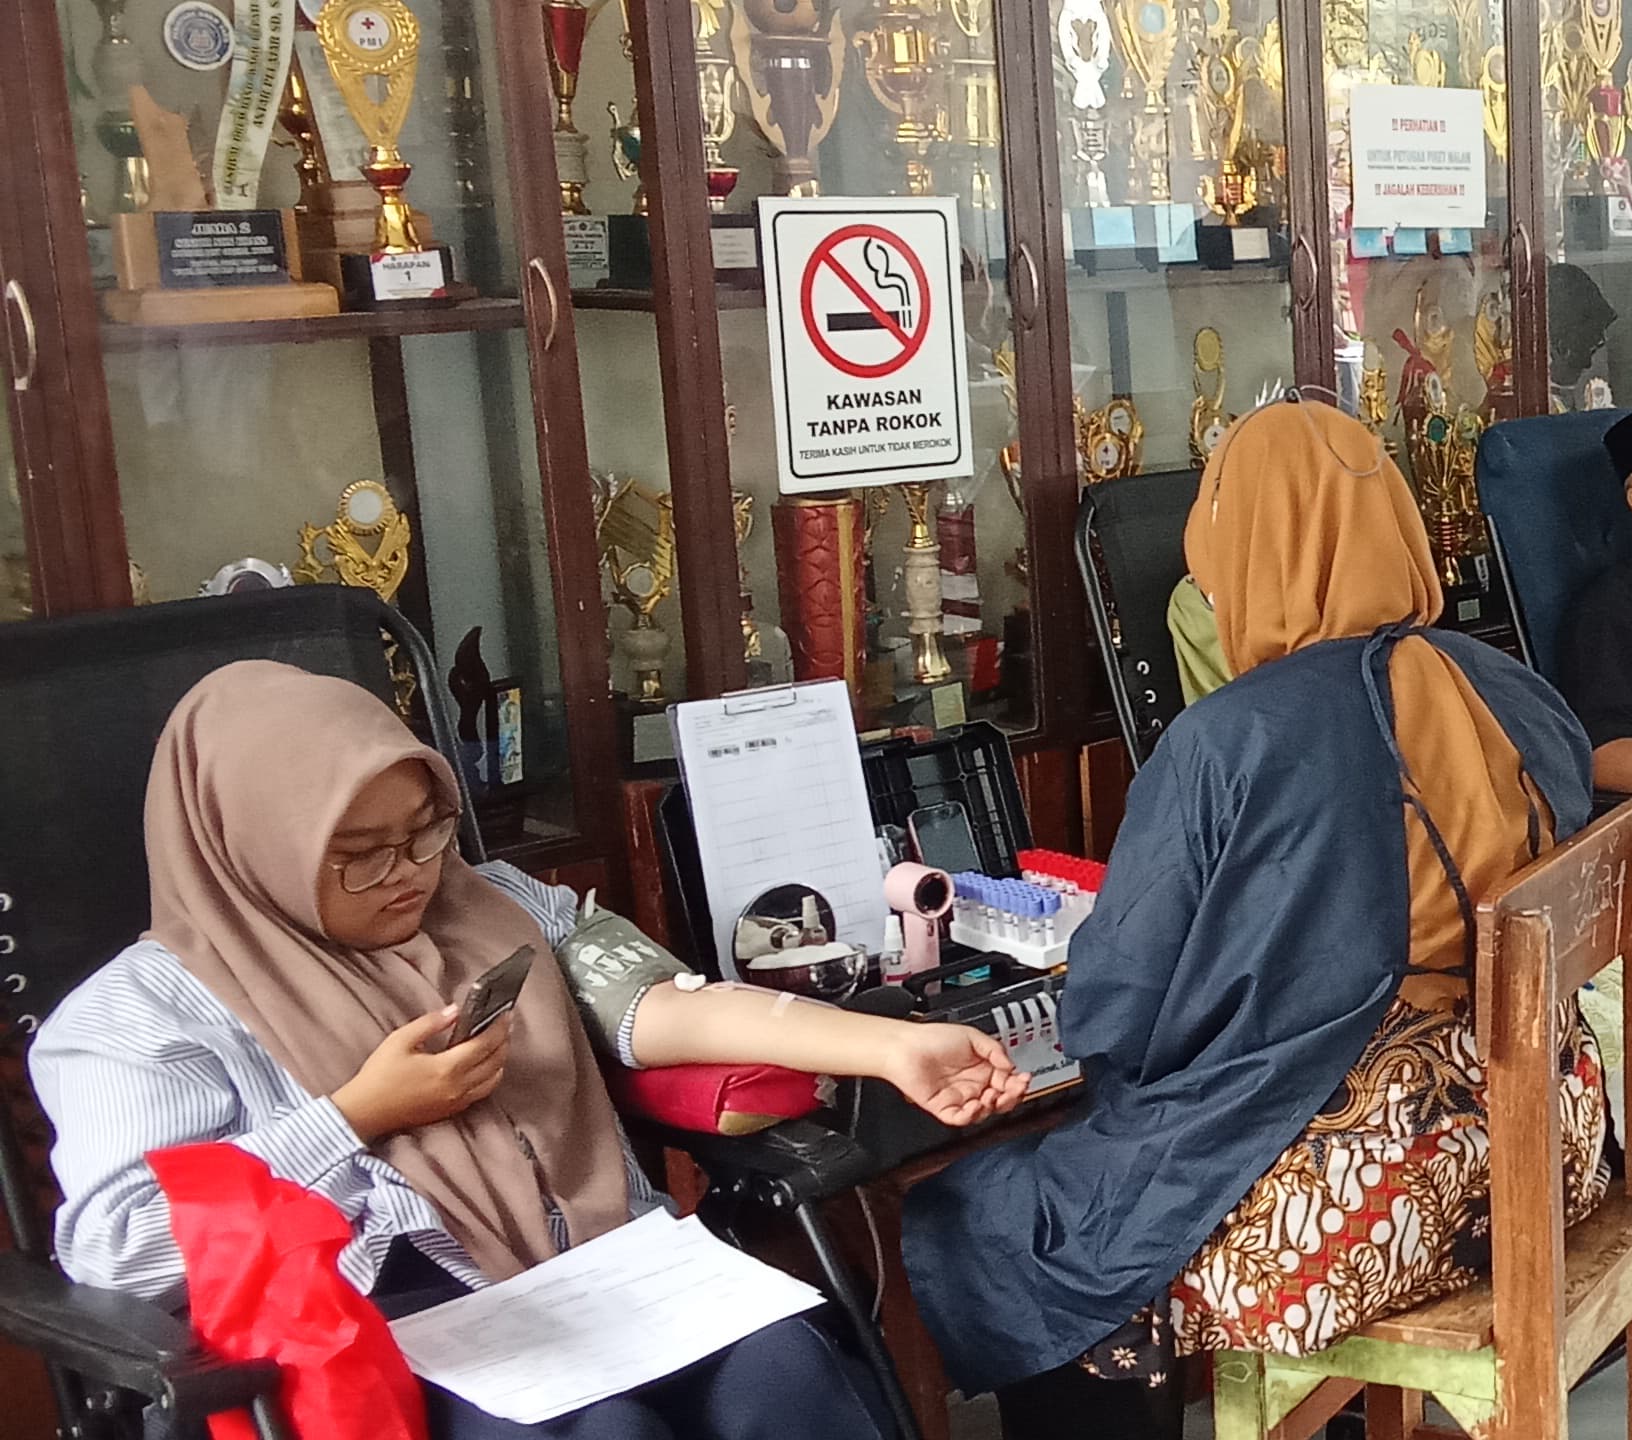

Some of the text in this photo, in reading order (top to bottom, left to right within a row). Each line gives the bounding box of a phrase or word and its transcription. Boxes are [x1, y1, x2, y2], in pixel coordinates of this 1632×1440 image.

[826, 388, 922, 411] KAWASAN
[806, 412, 942, 438] TANPA ROKOK
[799, 437, 953, 460] TERIMA KASIH UNTUK TIDAK MEROKOK
